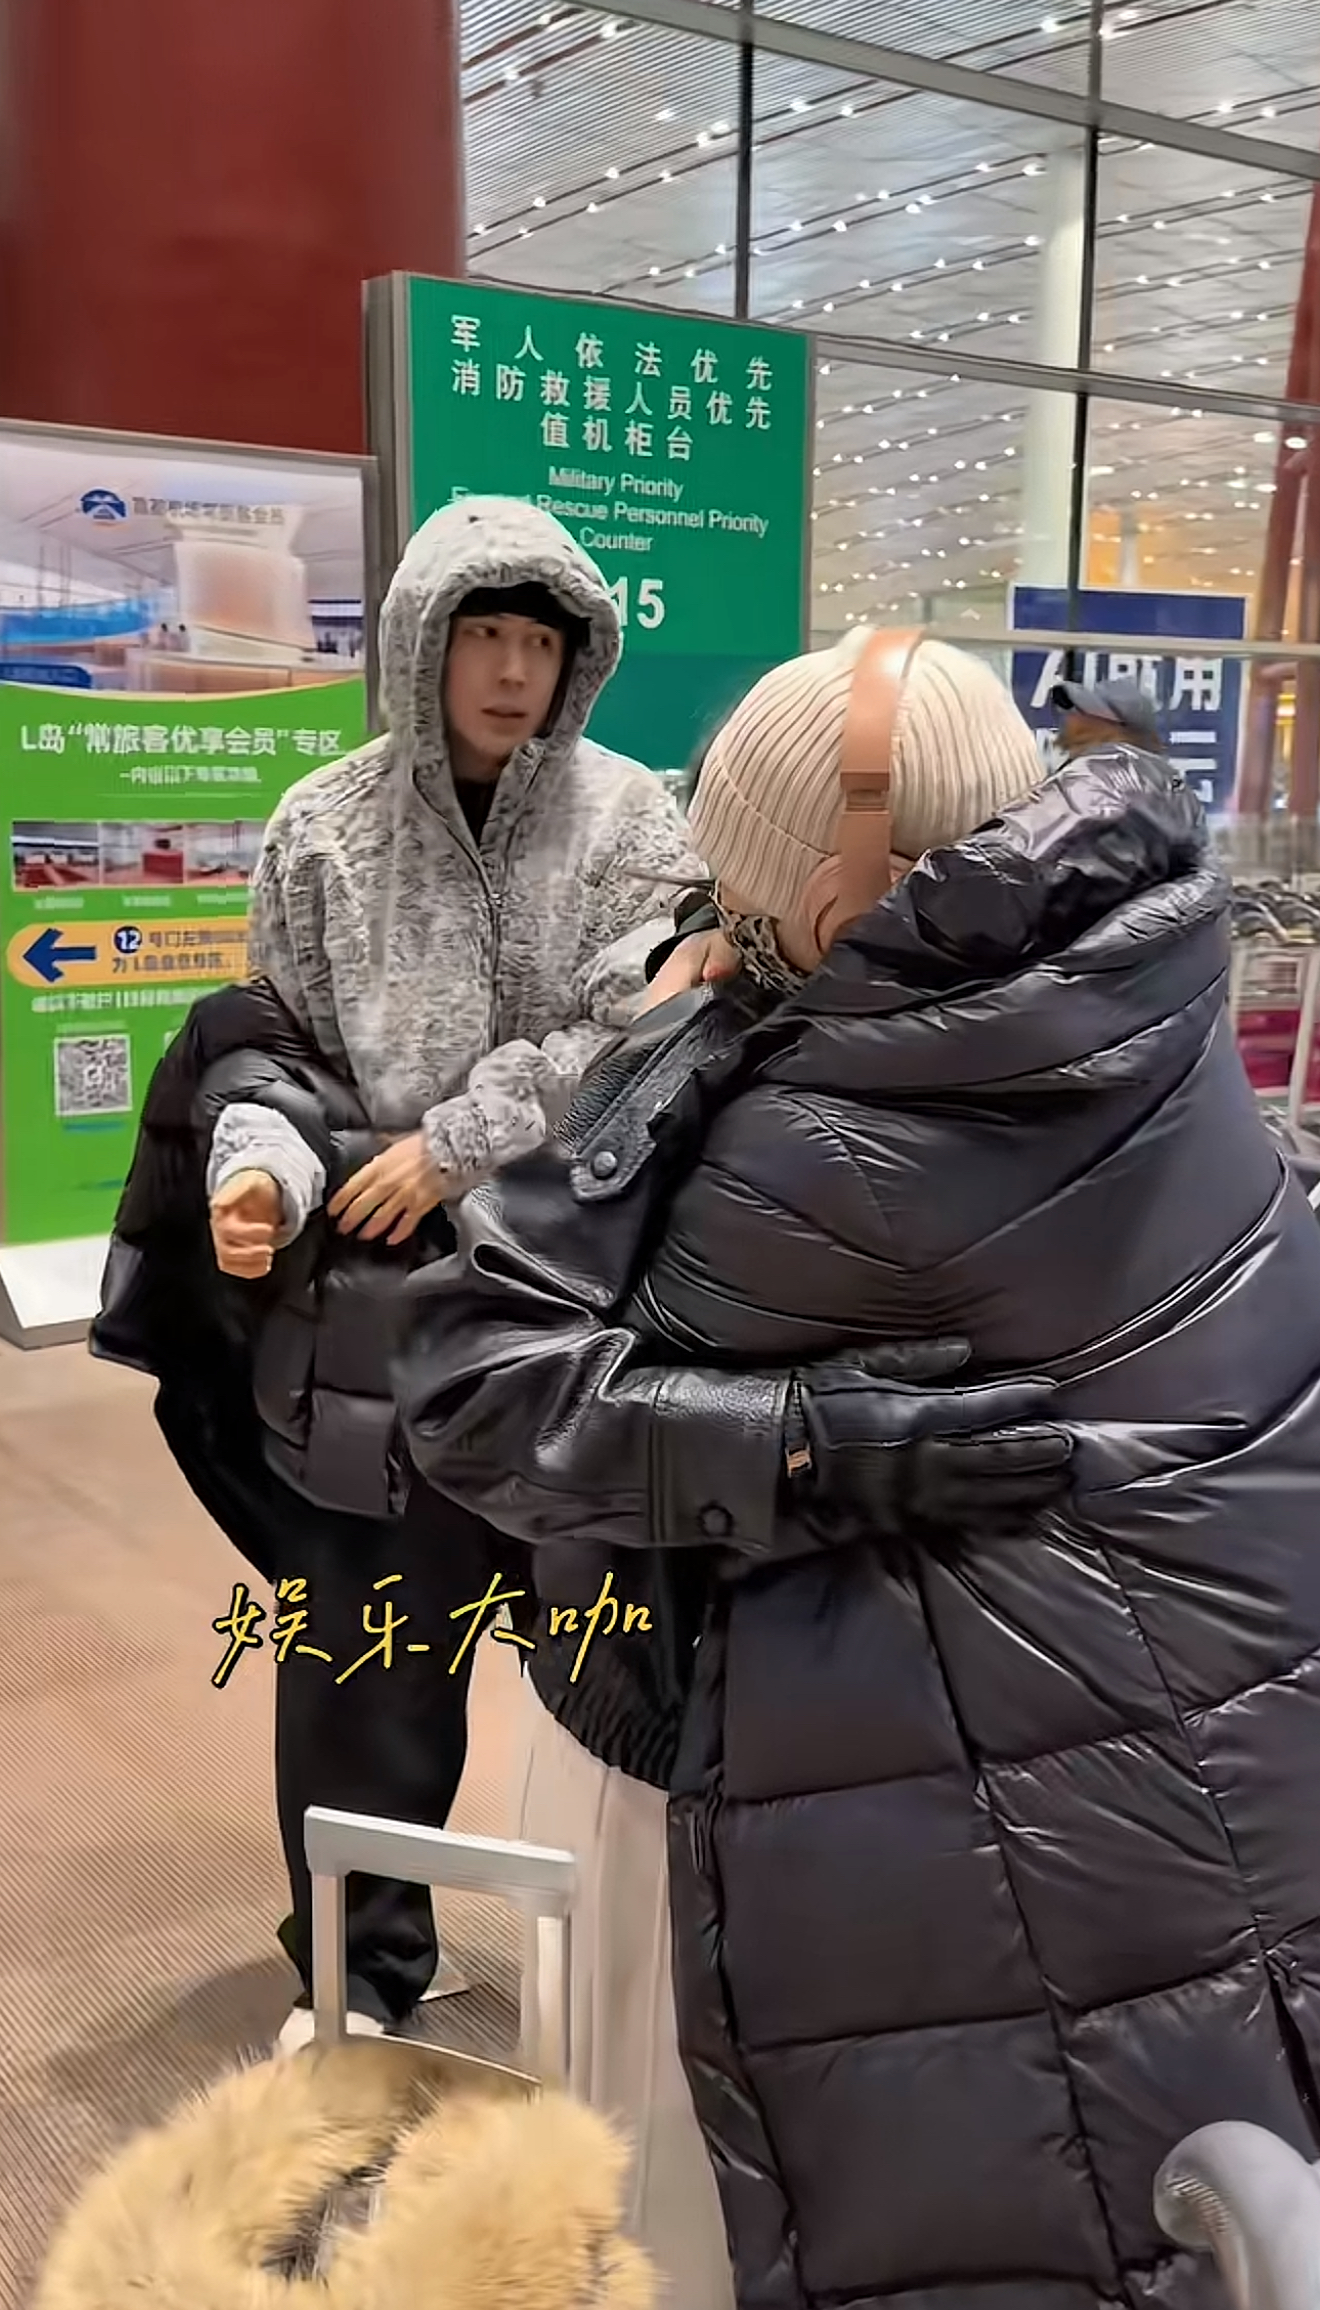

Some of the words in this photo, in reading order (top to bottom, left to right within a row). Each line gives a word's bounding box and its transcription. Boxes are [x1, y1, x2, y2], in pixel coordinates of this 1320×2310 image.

[450, 314, 773, 392] 军人依法优先
[451, 358, 772, 430] 消防救援人员优先
[540, 410, 694, 461] 值机柜台
[548, 465, 615, 495] Military
[620, 473, 684, 503] Priority
[537, 494, 608, 521] Rescue
[613, 501, 704, 529] Personnel
[708, 511, 769, 539] Priority
[579, 527, 654, 552] Counter
[116, 929, 142, 951] 12
